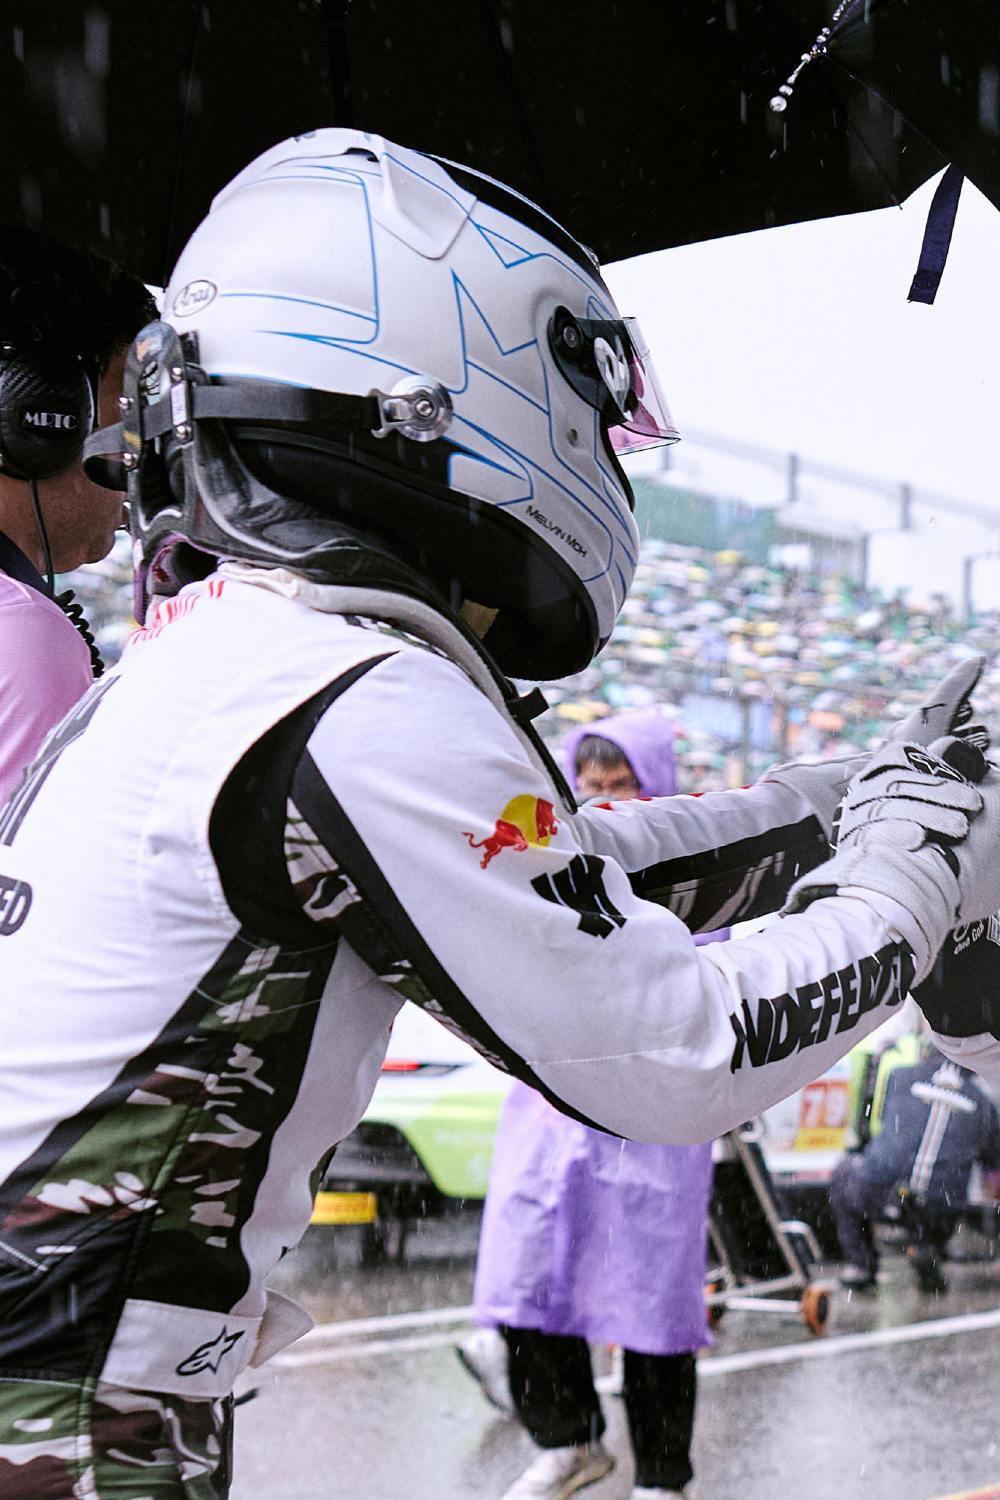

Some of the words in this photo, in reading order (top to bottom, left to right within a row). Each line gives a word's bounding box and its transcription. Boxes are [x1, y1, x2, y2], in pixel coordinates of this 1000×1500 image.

[23, 411, 78, 430] MRTC
[525, 505, 567, 540] MELVIN
[565, 533, 588, 558] MOH
